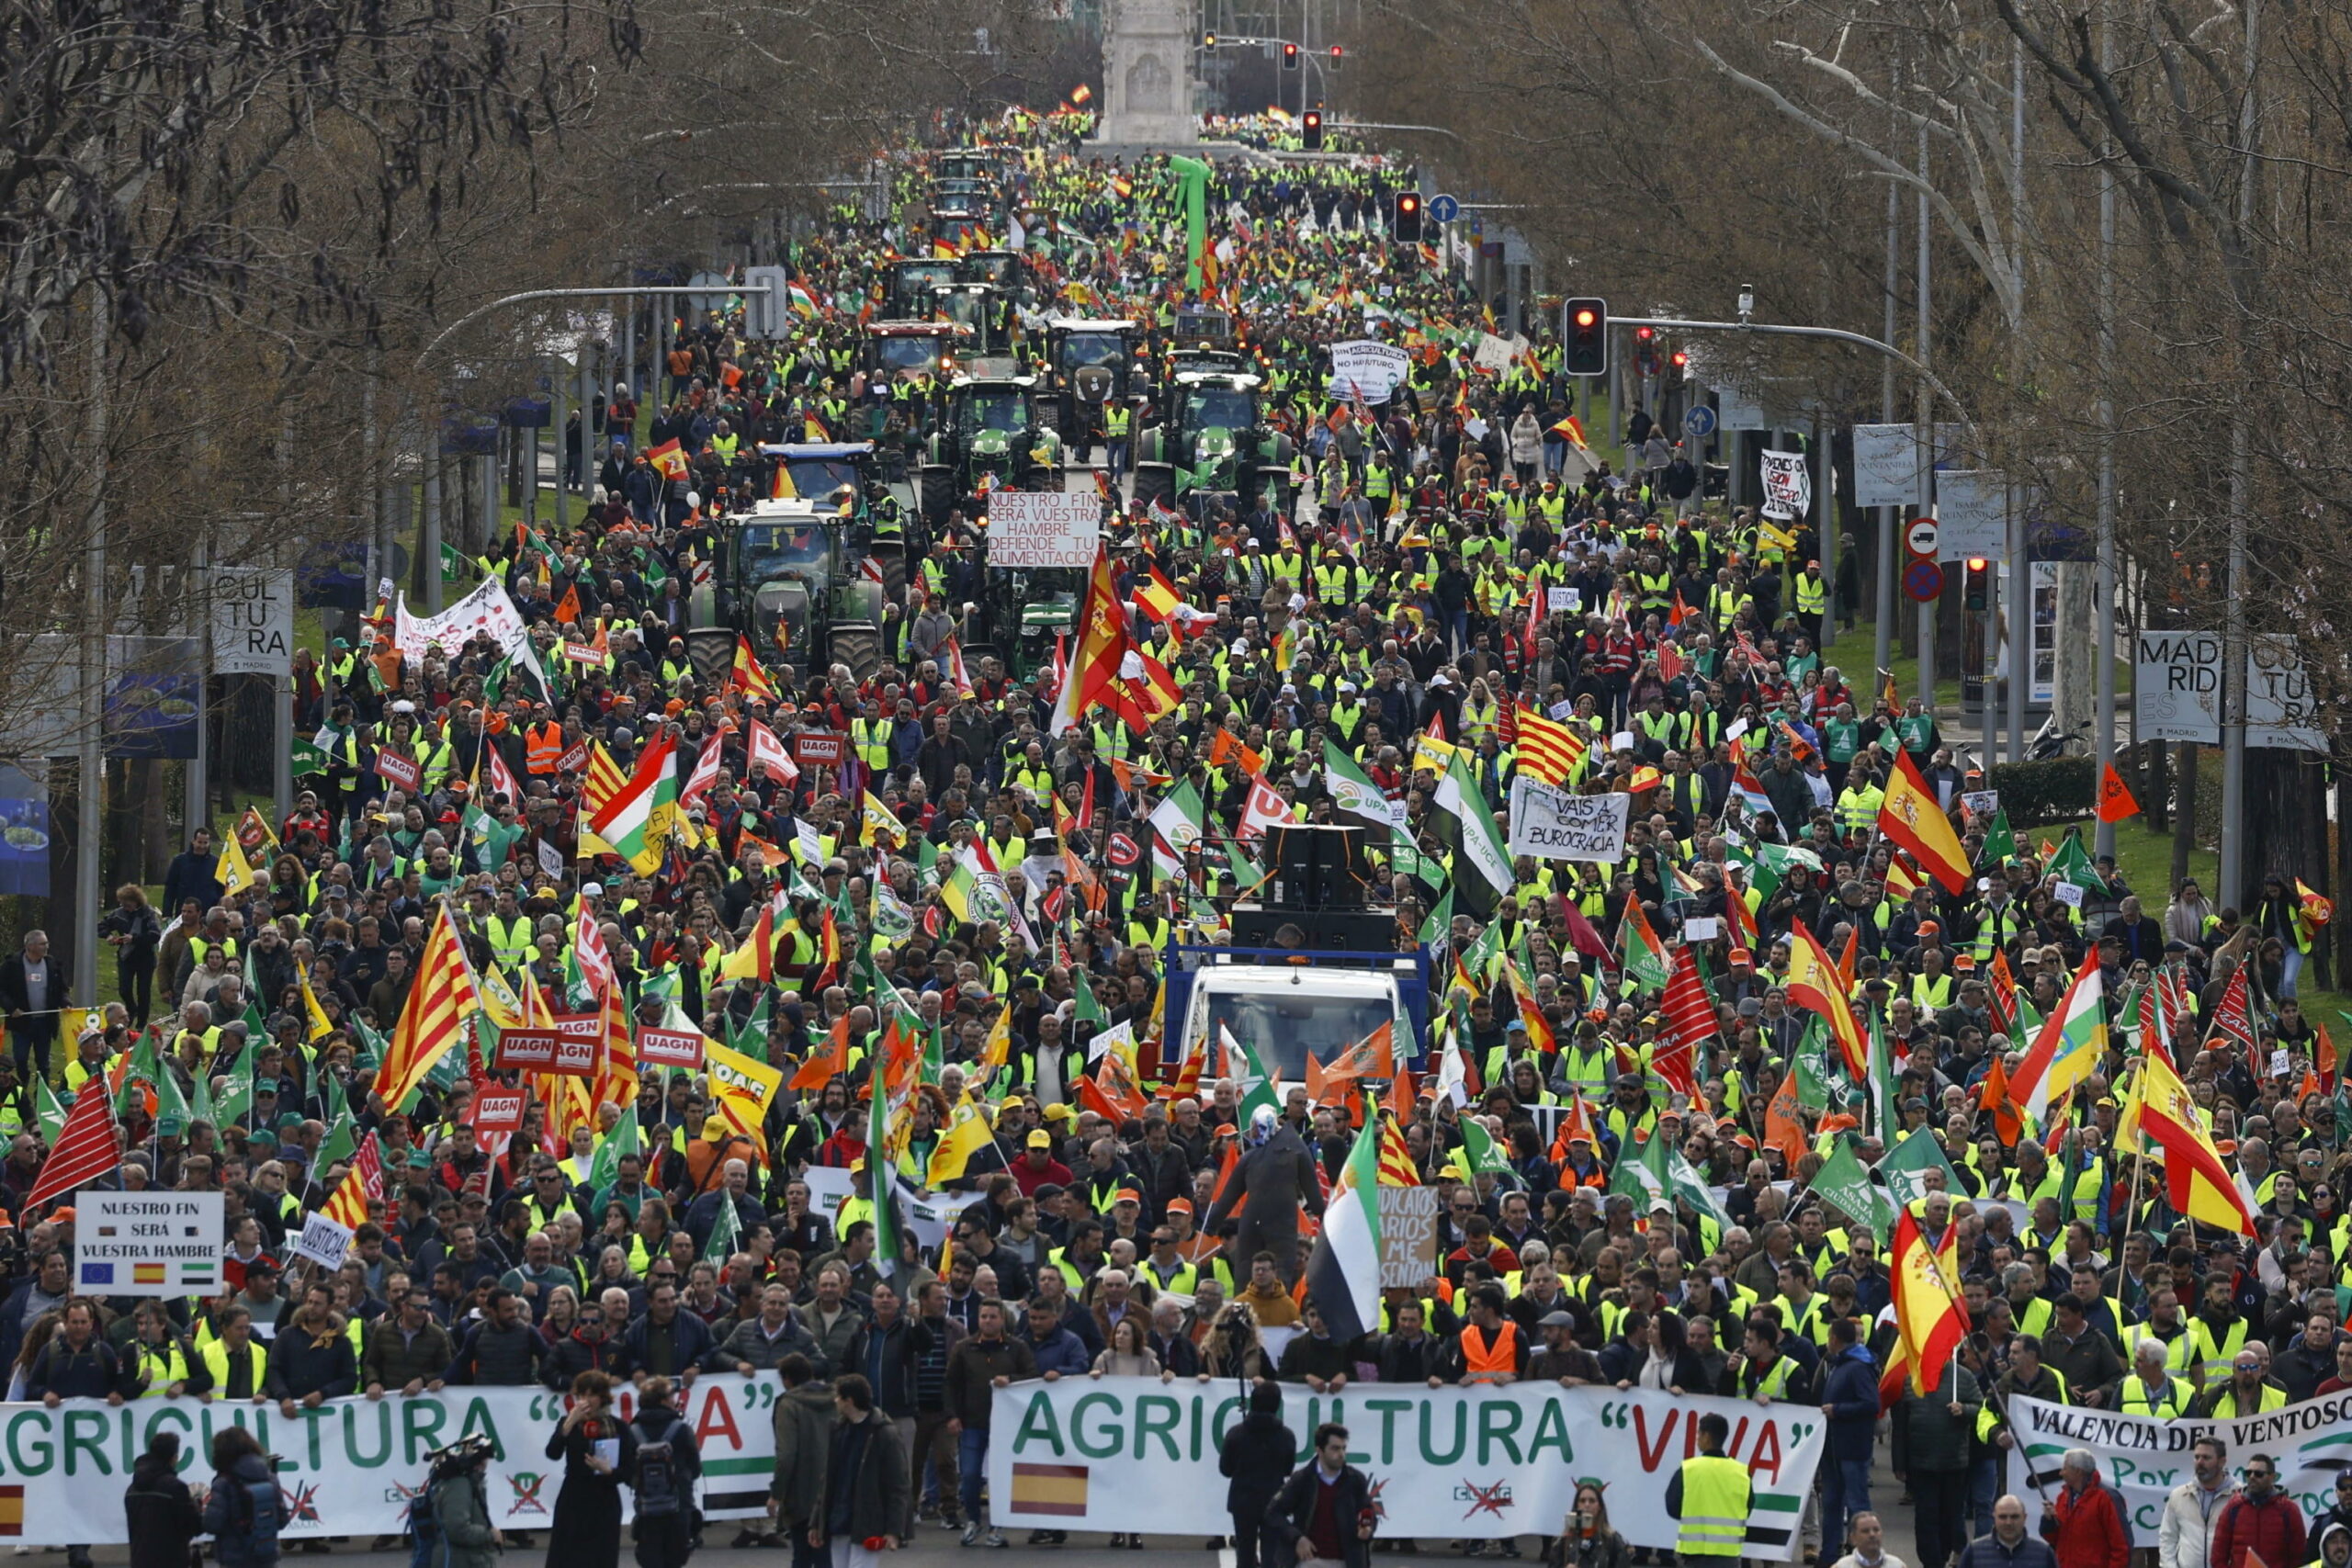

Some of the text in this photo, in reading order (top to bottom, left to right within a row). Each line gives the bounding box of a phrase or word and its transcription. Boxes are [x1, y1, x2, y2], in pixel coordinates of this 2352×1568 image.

[989, 494, 1098, 507] NUESTRO FIN
[989, 508, 1101, 522] SERA VUESTRA
[1007, 523, 1070, 536] HAMBRE
[989, 536, 1094, 550] DEFIENDE TU
[227, 603, 265, 626] TU
[248, 629, 288, 656] RA
[2140, 638, 2218, 664] MAD
[570, 647, 599, 657] UAGN
[243, 661, 271, 670] MADRID
[2168, 666, 2217, 692] RID
[2263, 673, 2305, 699] TU
[2166, 728, 2199, 737] MADRID
[802, 740, 836, 751] UAGN
[383, 755, 413, 776] UAGN
[558, 747, 582, 769] UAGN
[1365, 797, 1387, 814] UPA
[1555, 797, 1610, 815] VAIS A
[1556, 815, 1618, 833] COMER
[1463, 822, 1498, 870] UPA-UCE
[1529, 828, 1615, 852] BUROCRACIA
[506, 1038, 553, 1052] UAGN
[647, 1035, 694, 1051] UAGN
[1656, 1032, 1680, 1050] ORA
[558, 1043, 591, 1058] AGN
[482, 1100, 518, 1112] UAGN
[101, 1202, 199, 1215] NUESTRO FIN
[1379, 1188, 1439, 1217] DICATOS
[130, 1223, 169, 1236] SERÁ
[1380, 1216, 1431, 1240] ARIOS
[82, 1245, 217, 1258] VUESTRA HAMBRE
[1387, 1242, 1420, 1264] ME
[1380, 1262, 1435, 1288] SENTAN
[0, 1395, 505, 1477] GRICULTURA
[2031, 1405, 2159, 1451] VALENCIA
[2109, 1456, 2179, 1488] Por
